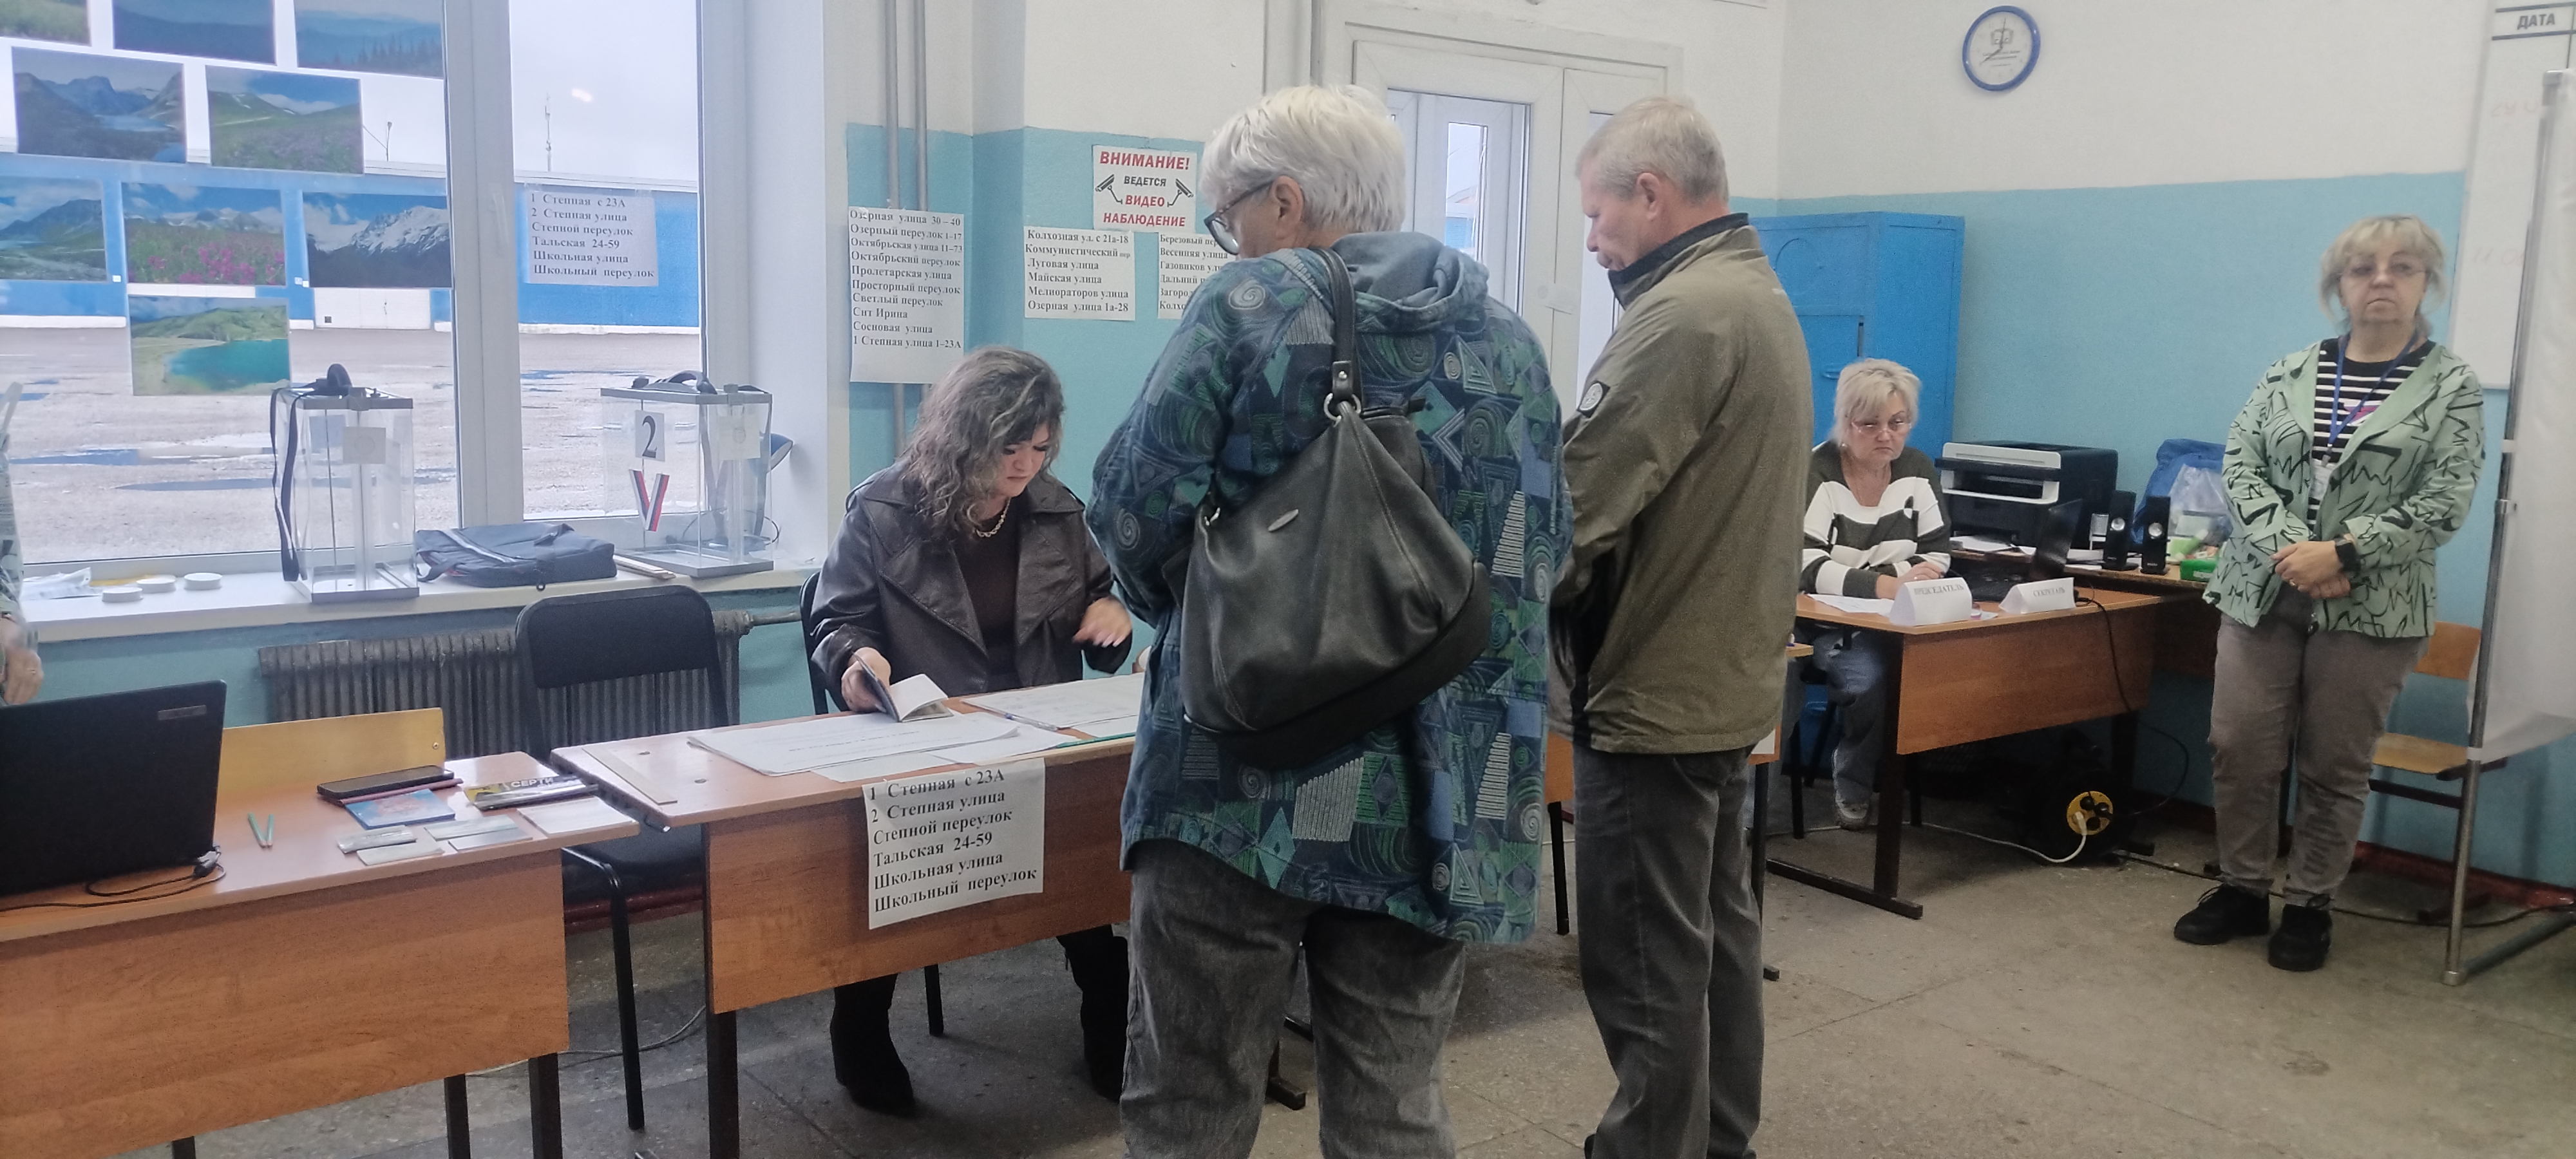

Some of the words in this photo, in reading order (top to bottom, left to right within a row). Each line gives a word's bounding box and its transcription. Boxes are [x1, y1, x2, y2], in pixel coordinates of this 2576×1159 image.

[2517, 13, 2555, 30] ДАТА
[1100, 151, 1190, 170] ВНИМАНИЕ!
[1124, 176, 1166, 187] ВЕДЕТСЯ
[531, 193, 535, 202] 1
[543, 194, 591, 205] Степная
[606, 198, 625, 207] 23А
[1125, 194, 1165, 207] ВИДЕО
[531, 208, 537, 216] 2
[544, 209, 591, 220] Степная
[594, 213, 627, 222] улица
[850, 210, 893, 222] Озерная
[899, 214, 927, 223] улица
[931, 216, 941, 225] 30
[1103, 212, 1186, 227] НАБЛЮДЕНИЕ
[532, 222, 580, 233] Степной
[583, 227, 633, 236] переулок
[851, 223, 898, 236] Озерный
[901, 229, 943, 240] переулок
[1027, 229, 1079, 241] Колхозная
[533, 236, 585, 247] Тальская
[592, 240, 620, 249] 24-59
[851, 238, 911, 250] Октябрьская
[914, 243, 938, 252] улица
[1160, 234, 1203, 245] Березовый
[533, 250, 592, 261] Школьная
[596, 255, 628, 264] улица
[1025, 243, 1118, 257] Коммунистический
[1160, 247, 1200, 258] Весенняя
[1202, 251, 1228, 260] улица
[851, 250, 918, 264] Октябрьский
[922, 258, 960, 267] переулок
[1027, 258, 1068, 270] Луговая
[1070, 262, 1099, 271] улица
[534, 265, 597, 276] Школьный
[603, 269, 654, 279] переулок
[852, 265, 922, 279] Пролетарская
[925, 272, 952, 281] улица
[1160, 261, 1205, 271] Газовиков
[1028, 272, 1071, 283] Майская
[1074, 276, 1102, 285] улица
[1160, 274, 1198, 284] Дальний
[852, 279, 914, 292] Просторный
[918, 285, 960, 296] переулок
[1028, 286, 1098, 299] Мелиораторов
[1101, 291, 1128, 300] улица
[853, 292, 898, 304] Светлый
[902, 297, 943, 308] переулок
[1028, 300, 1068, 312] Озерная
[1073, 304, 1102, 313] улица
[1105, 303, 1128, 312] 1а-28
[876, 308, 907, 320] Ирина
[853, 321, 900, 332] Сосновая
[905, 326, 933, 335] улица
[854, 335, 857, 344] 1
[861, 335, 903, 346] Степная
[905, 340, 933, 348] улица
[642, 415, 658, 458] 2
[869, 786, 876, 800] 1
[887, 777, 955, 798] Степная
[965, 777, 972, 786] с
[976, 769, 1005, 785] 23А
[871, 809, 878, 822] 2
[887, 800, 954, 819] Степная
[960, 792, 1005, 811] улица
[873, 820, 937, 845] Степной
[942, 810, 1012, 832] переулок
[874, 843, 944, 867] Тальская
[953, 832, 993, 851] 24-59
[874, 863, 953, 890] Школьная
[958, 854, 1003, 875] улица
[875, 881, 959, 912] Школьный
[968, 869, 1037, 890] переулок
